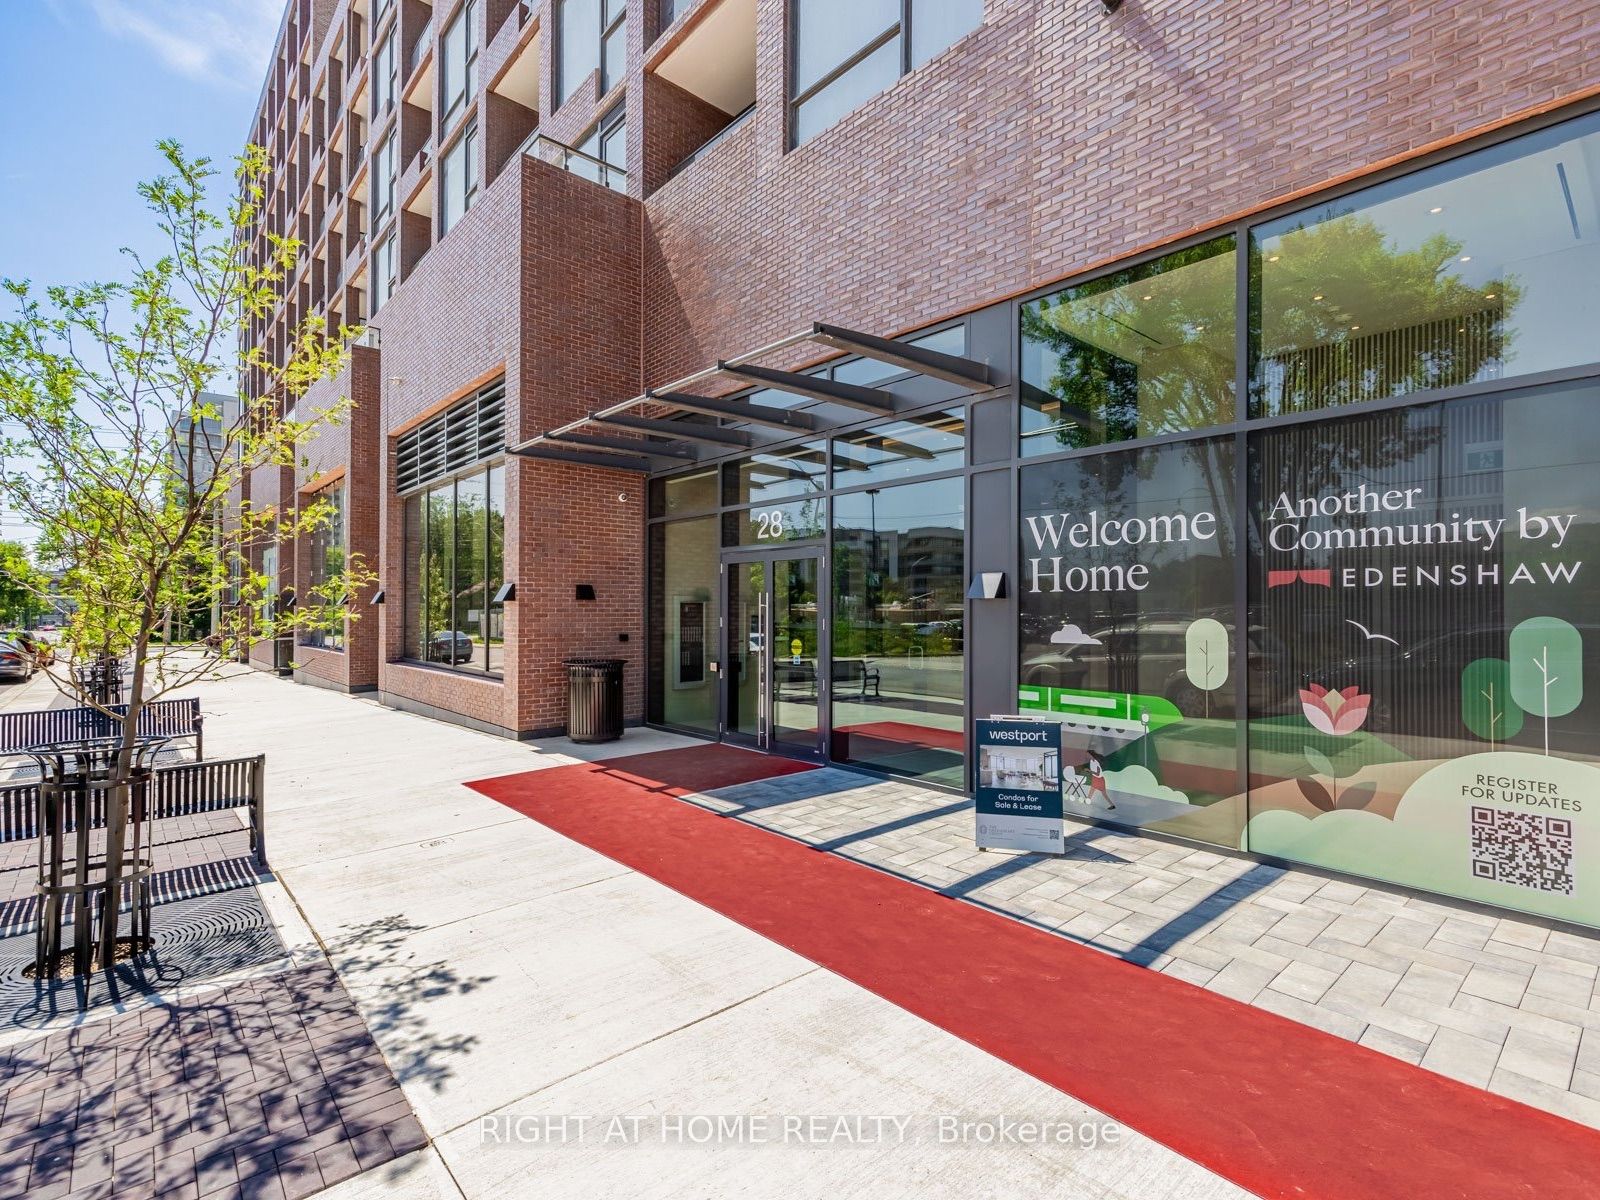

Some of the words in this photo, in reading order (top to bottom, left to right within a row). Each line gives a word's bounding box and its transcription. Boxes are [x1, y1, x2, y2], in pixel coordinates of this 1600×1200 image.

[1267, 484, 1422, 520] Another
[757, 510, 783, 539] 28
[1025, 510, 1217, 550] Welcome
[1269, 513, 1507, 551] Community
[1516, 507, 1578, 548] by
[1028, 556, 1150, 593] Home
[1342, 561, 1583, 587] EDENSHAW
[989, 729, 1048, 743] westport
[998, 793, 1026, 802] Condos
[1027, 794, 1039, 802] for
[1476, 774, 1558, 795] REGISTER
[995, 801, 1011, 809] Sale
[1020, 803, 1042, 811] Lease
[1462, 785, 1496, 801] FOR
[1502, 790, 1582, 812] UPDATES
